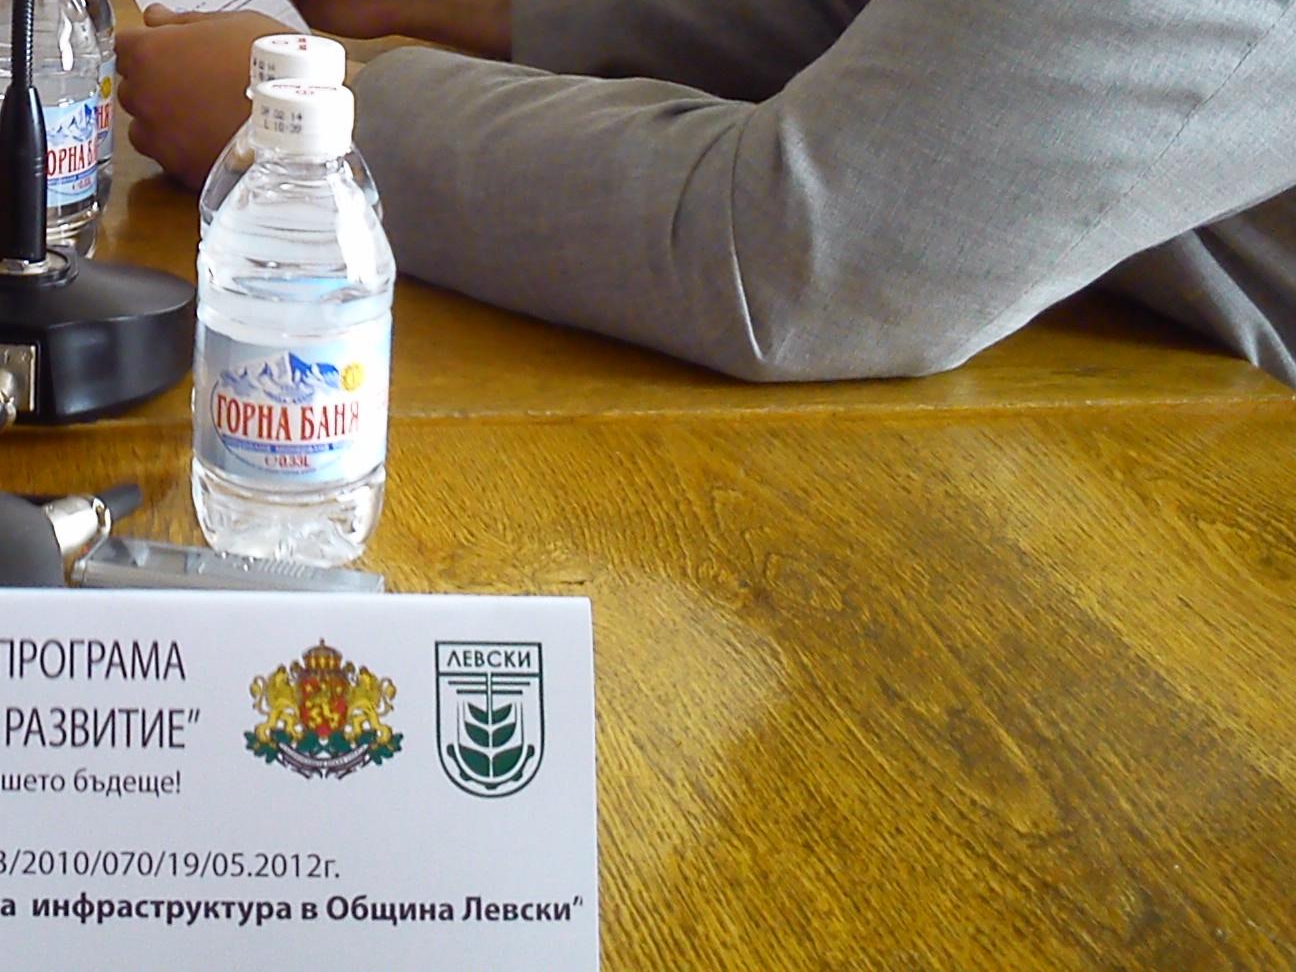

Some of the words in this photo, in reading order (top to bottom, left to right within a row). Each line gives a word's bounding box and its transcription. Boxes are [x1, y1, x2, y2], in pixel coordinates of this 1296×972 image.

[47, 144, 84, 177] ОРНА
[216, 393, 292, 442] ГОРНА
[300, 401, 360, 441] БАНЯ
[446, 649, 532, 669] ЛЕВСКИ
[5, 705, 201, 750] РАЗВИТИЕ”
[73, 767, 181, 799] бъдеще!
[31, 891, 293, 927] инфраструктура
[300, 901, 319, 921] в
[325, 894, 455, 927] Община
[461, 894, 584, 923] Левски”
